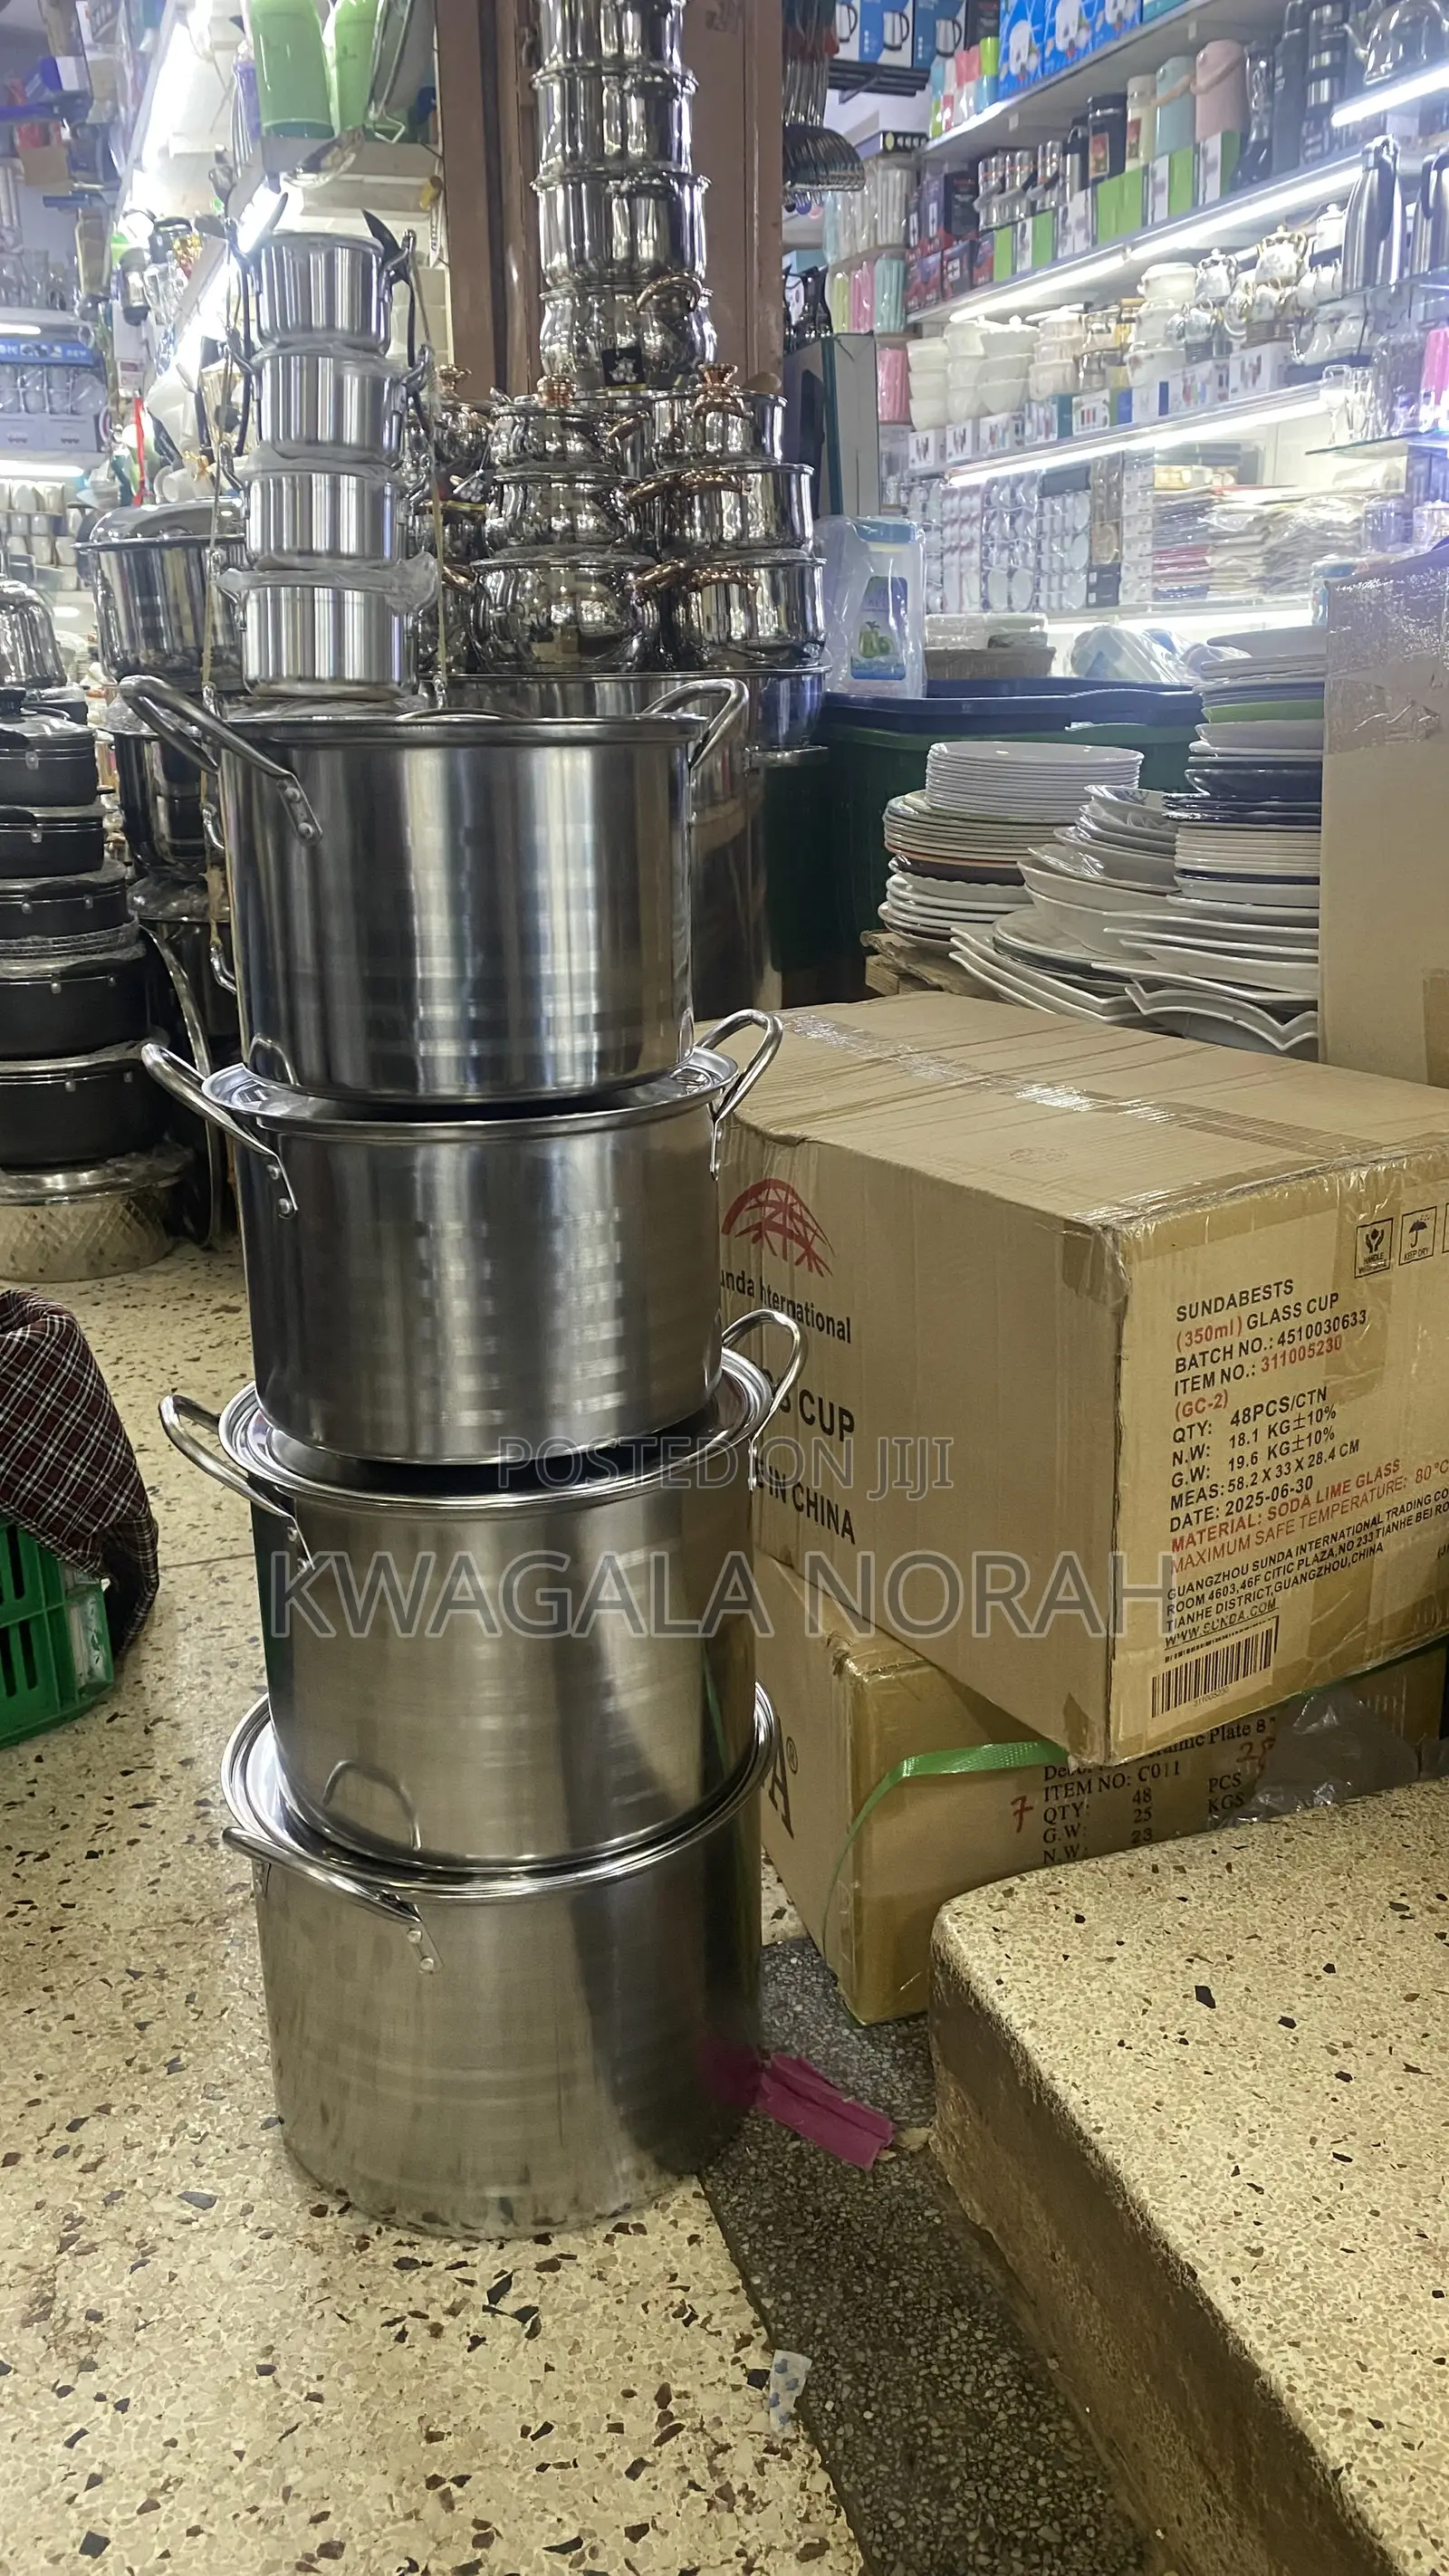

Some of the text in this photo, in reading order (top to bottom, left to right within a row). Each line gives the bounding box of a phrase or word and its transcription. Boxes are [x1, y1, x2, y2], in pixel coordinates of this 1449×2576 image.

[1176, 1278, 1293, 1322] SUNDABESTS
[1247, 1302, 1301, 1330] GLASS
[1307, 1292, 1339, 1314] CUP
[1175, 1334, 1342, 1396] ITEM NO.: 311005230
[1176, 1309, 1367, 1374] BATCH NO.: 4510030633
[799, 1388, 855, 1442] CUP
[1173, 1386, 1328, 1443] QTY: 48PCS/CTN
[1175, 1389, 1229, 1422] (GC-2)
[1171, 1465, 1211, 1488] G.W:
[1228, 1451, 1259, 1471] 19.6
[1172, 1443, 1211, 1467] N.W:
[1229, 1428, 1259, 1449] 18.1
[1170, 1438, 1360, 1511] MEAS: 58.2 X 33 X 28.4 CM
[768, 1465, 787, 1504] IN
[792, 1481, 856, 1545] CHINA
[1169, 1475, 1314, 1533] DATE: 2025-06-30
[1170, 1535, 1251, 1574] MAXIMUM
[1254, 1518, 1296, 1547] SAFE
[1299, 1476, 1408, 1529] TEMPERATURE:
[1171, 1459, 1401, 1554] MATERIAL: SODA LIME GLASS
[1166, 1594, 1205, 1617] ROOM
[1208, 1575, 1262, 1601] 4603,46F
[1264, 1562, 1294, 1583] CITIC
[1356, 1532, 1374, 1548] 233
[1376, 1515, 1414, 1538] TIANHE
[1415, 1508, 1433, 1524] BEI
[1167, 1563, 1250, 1600] GUANGZHOU
[1252, 1548, 1294, 1572] SUNDA
[1296, 1513, 1384, 1556] INTERNATIONAL
[1387, 1494, 1432, 1521] TRADING
[1165, 1598, 1278, 1648] WWW.SUNDA.COM
[1166, 1606, 1213, 1633] TIANHE
[1208, 1724, 1252, 1745] Plate
[1043, 1778, 1092, 1803] ITEM
[1098, 1772, 1132, 1793] NO:
[1043, 1772, 1242, 1825] QTY: 48 PCS
[1133, 1806, 1153, 1824] 25
[1207, 1792, 1245, 1814] KGS
[1131, 1827, 1153, 1844] 23
